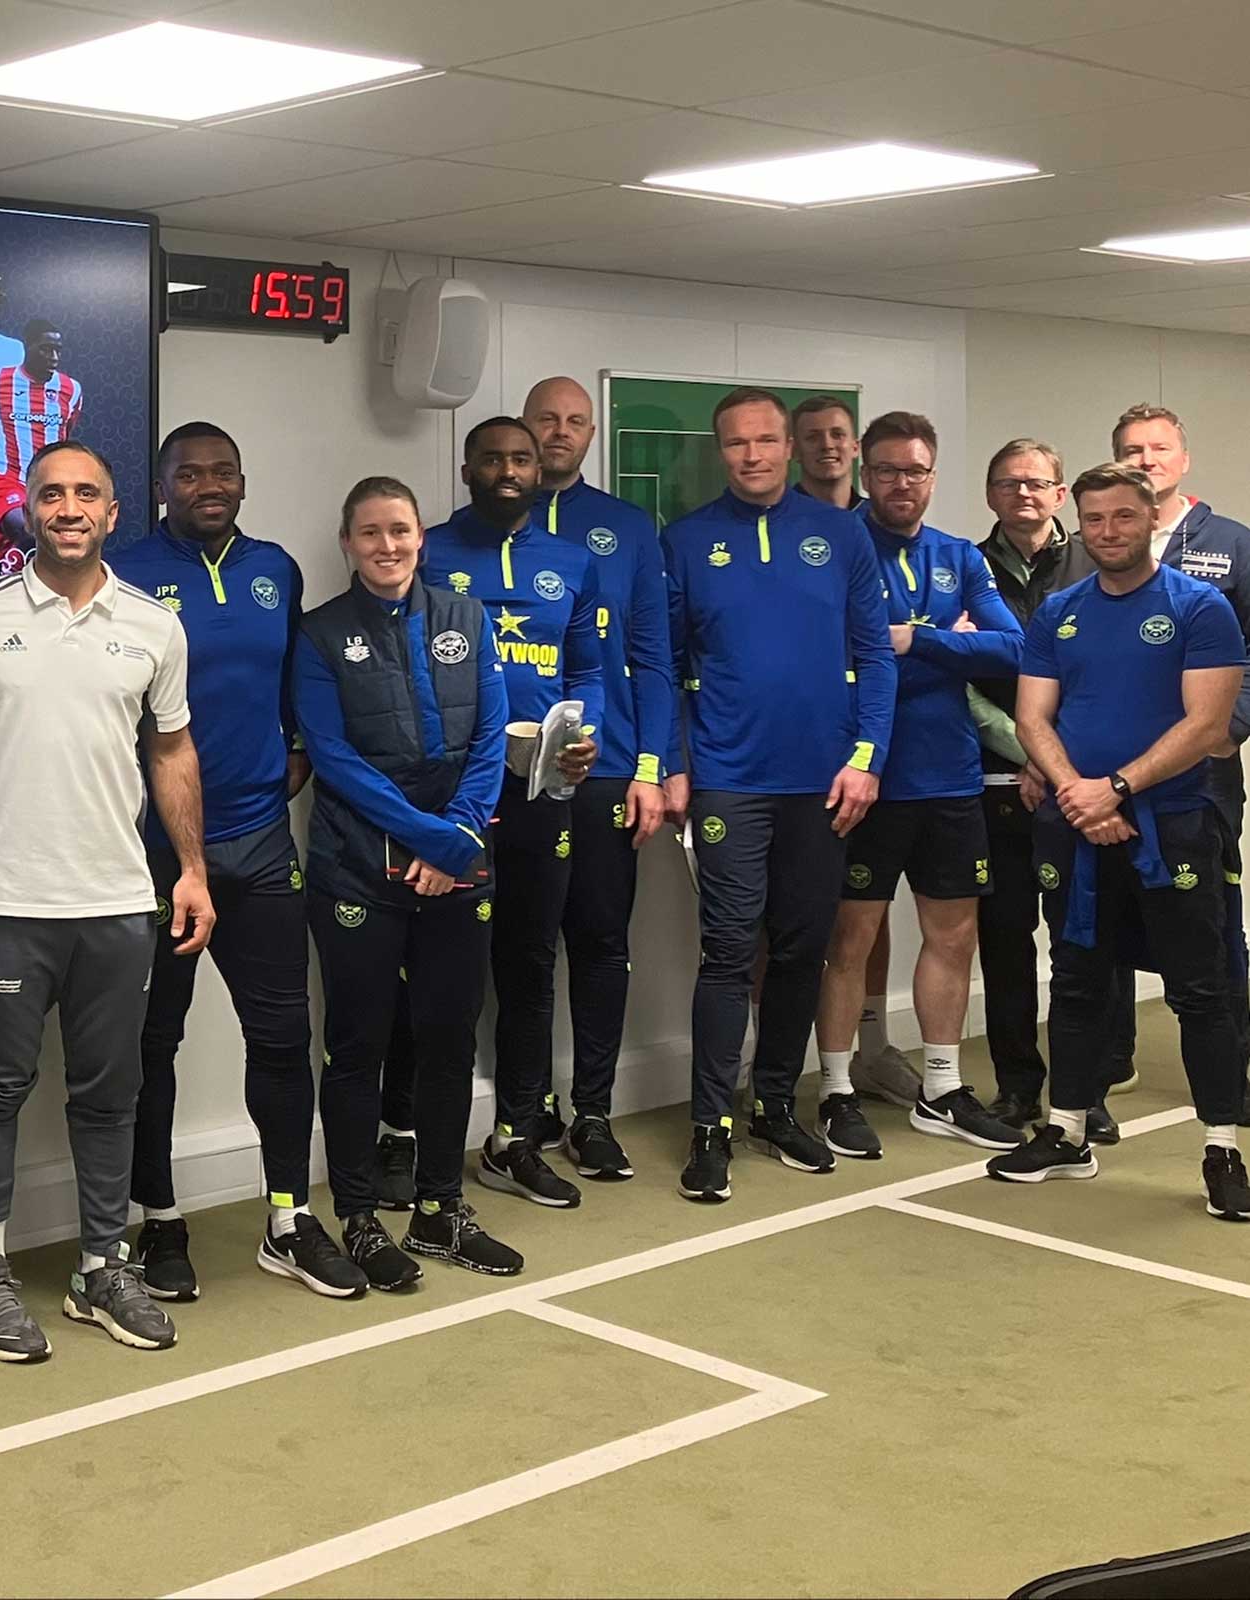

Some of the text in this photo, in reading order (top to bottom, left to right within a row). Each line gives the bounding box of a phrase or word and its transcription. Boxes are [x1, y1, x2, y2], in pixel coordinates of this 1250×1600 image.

[155, 585, 178, 597] JPP
[346, 636, 362, 646] LB
[497, 641, 558, 667] YWOOD
